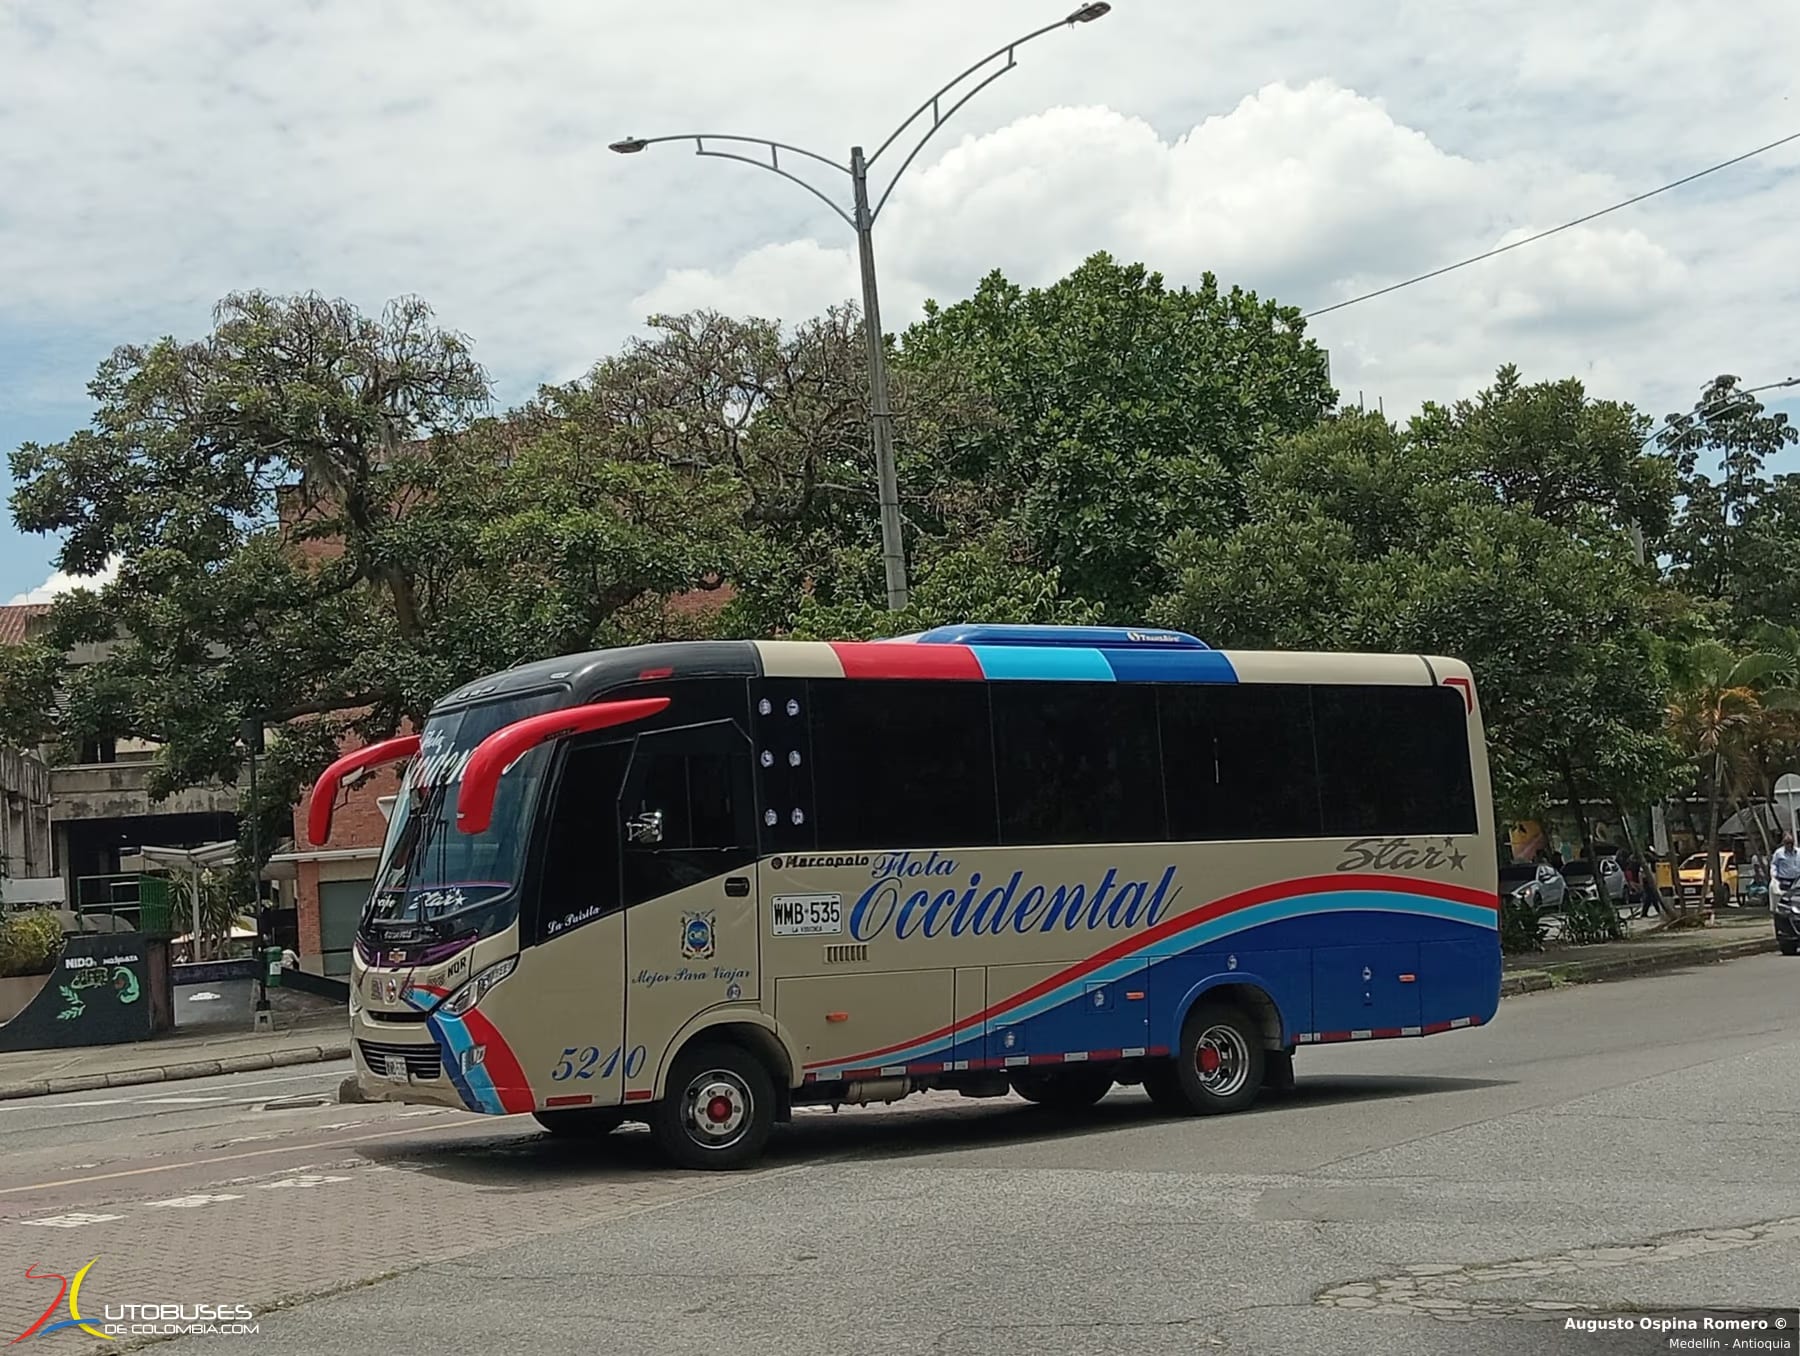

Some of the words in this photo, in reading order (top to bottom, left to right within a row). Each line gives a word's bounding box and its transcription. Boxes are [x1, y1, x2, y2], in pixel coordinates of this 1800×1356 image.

[785, 854, 870, 868] Marcopolo
[871, 850, 960, 878] Flota
[1336, 838, 1446, 871] Star
[849, 866, 1182, 942] Occidental
[631, 969, 671, 988] Mejor
[673, 967, 707, 981] Para
[713, 965, 751, 984] Viajar
[551, 1044, 647, 1081] 5210
